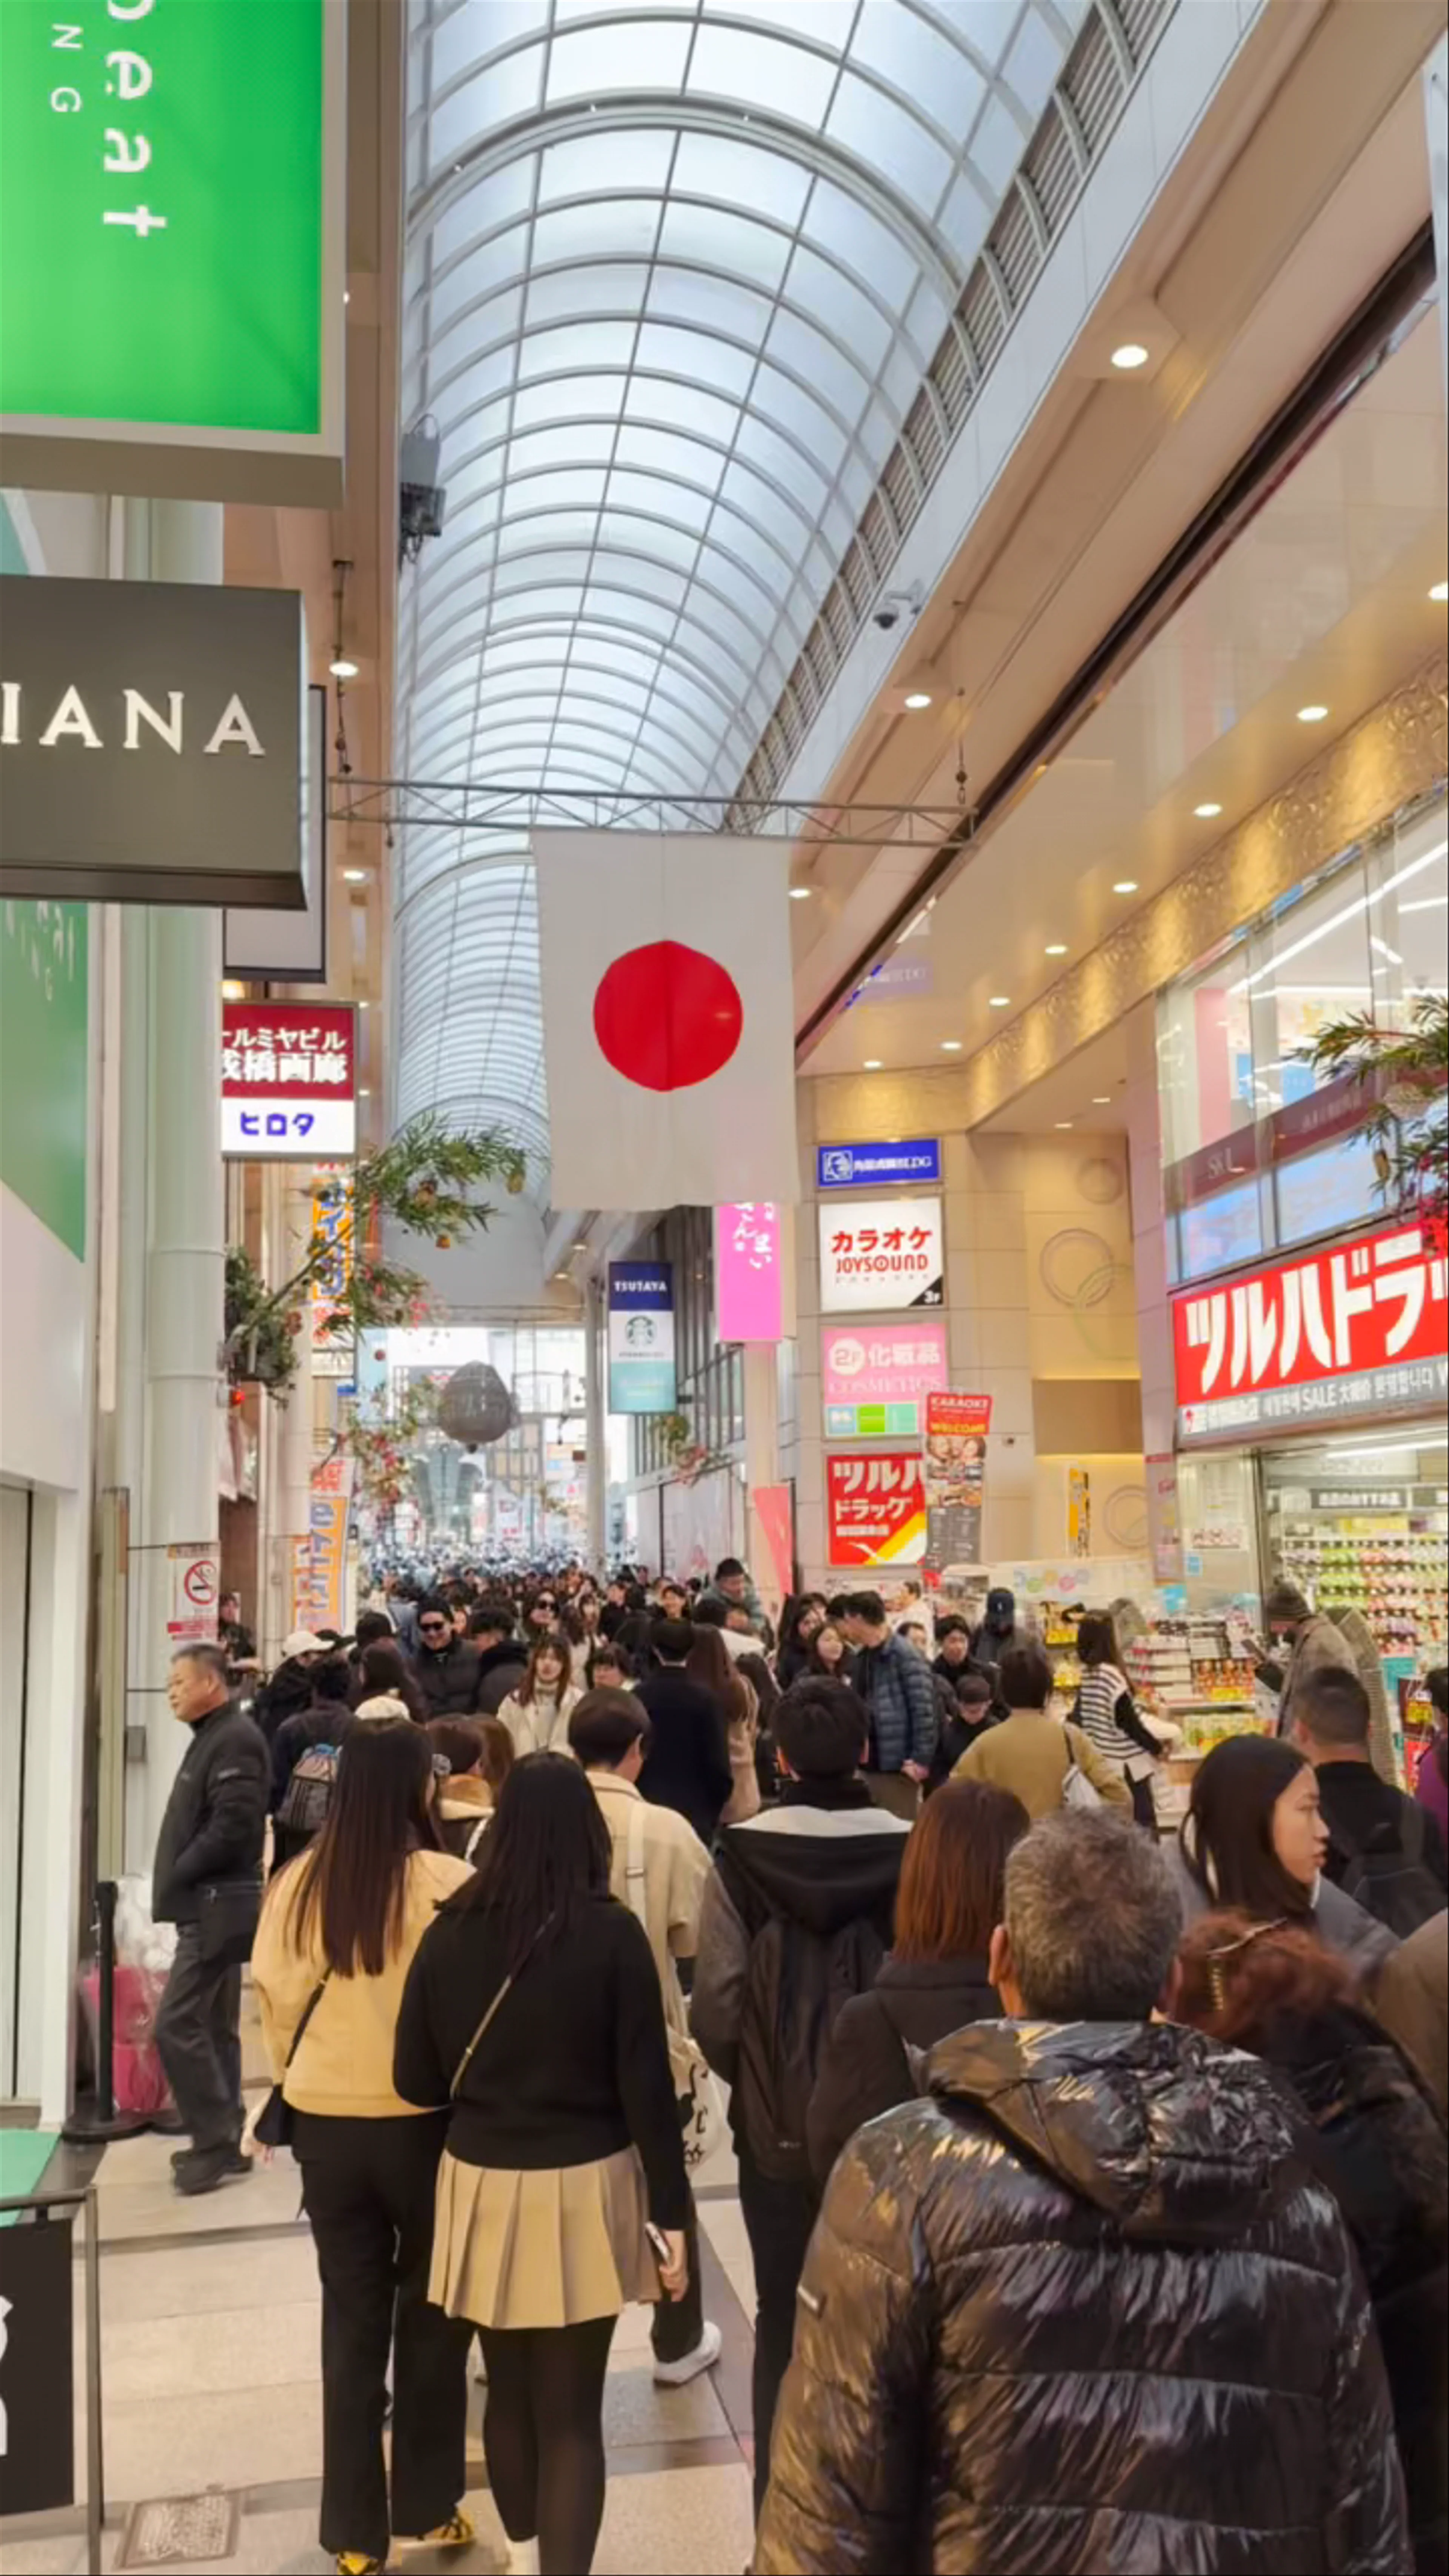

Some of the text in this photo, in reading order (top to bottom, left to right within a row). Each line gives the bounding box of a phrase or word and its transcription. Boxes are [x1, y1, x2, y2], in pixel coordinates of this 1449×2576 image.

[0, 682, 266, 755] IANA
[222, 1026, 347, 1051] ルミヤビル
[240, 1111, 315, 1137] ヒロタ
[831, 1226, 932, 1253] カラオケ
[836, 1254, 929, 1273] JOYSOUND
[614, 1280, 668, 1292] TSUTAYA
[924, 1291, 940, 1304] 3F
[868, 1341, 941, 1367] 化粧品
[1303, 1383, 1337, 1410] SALE
[834, 1497, 913, 1522] ドラッグ
